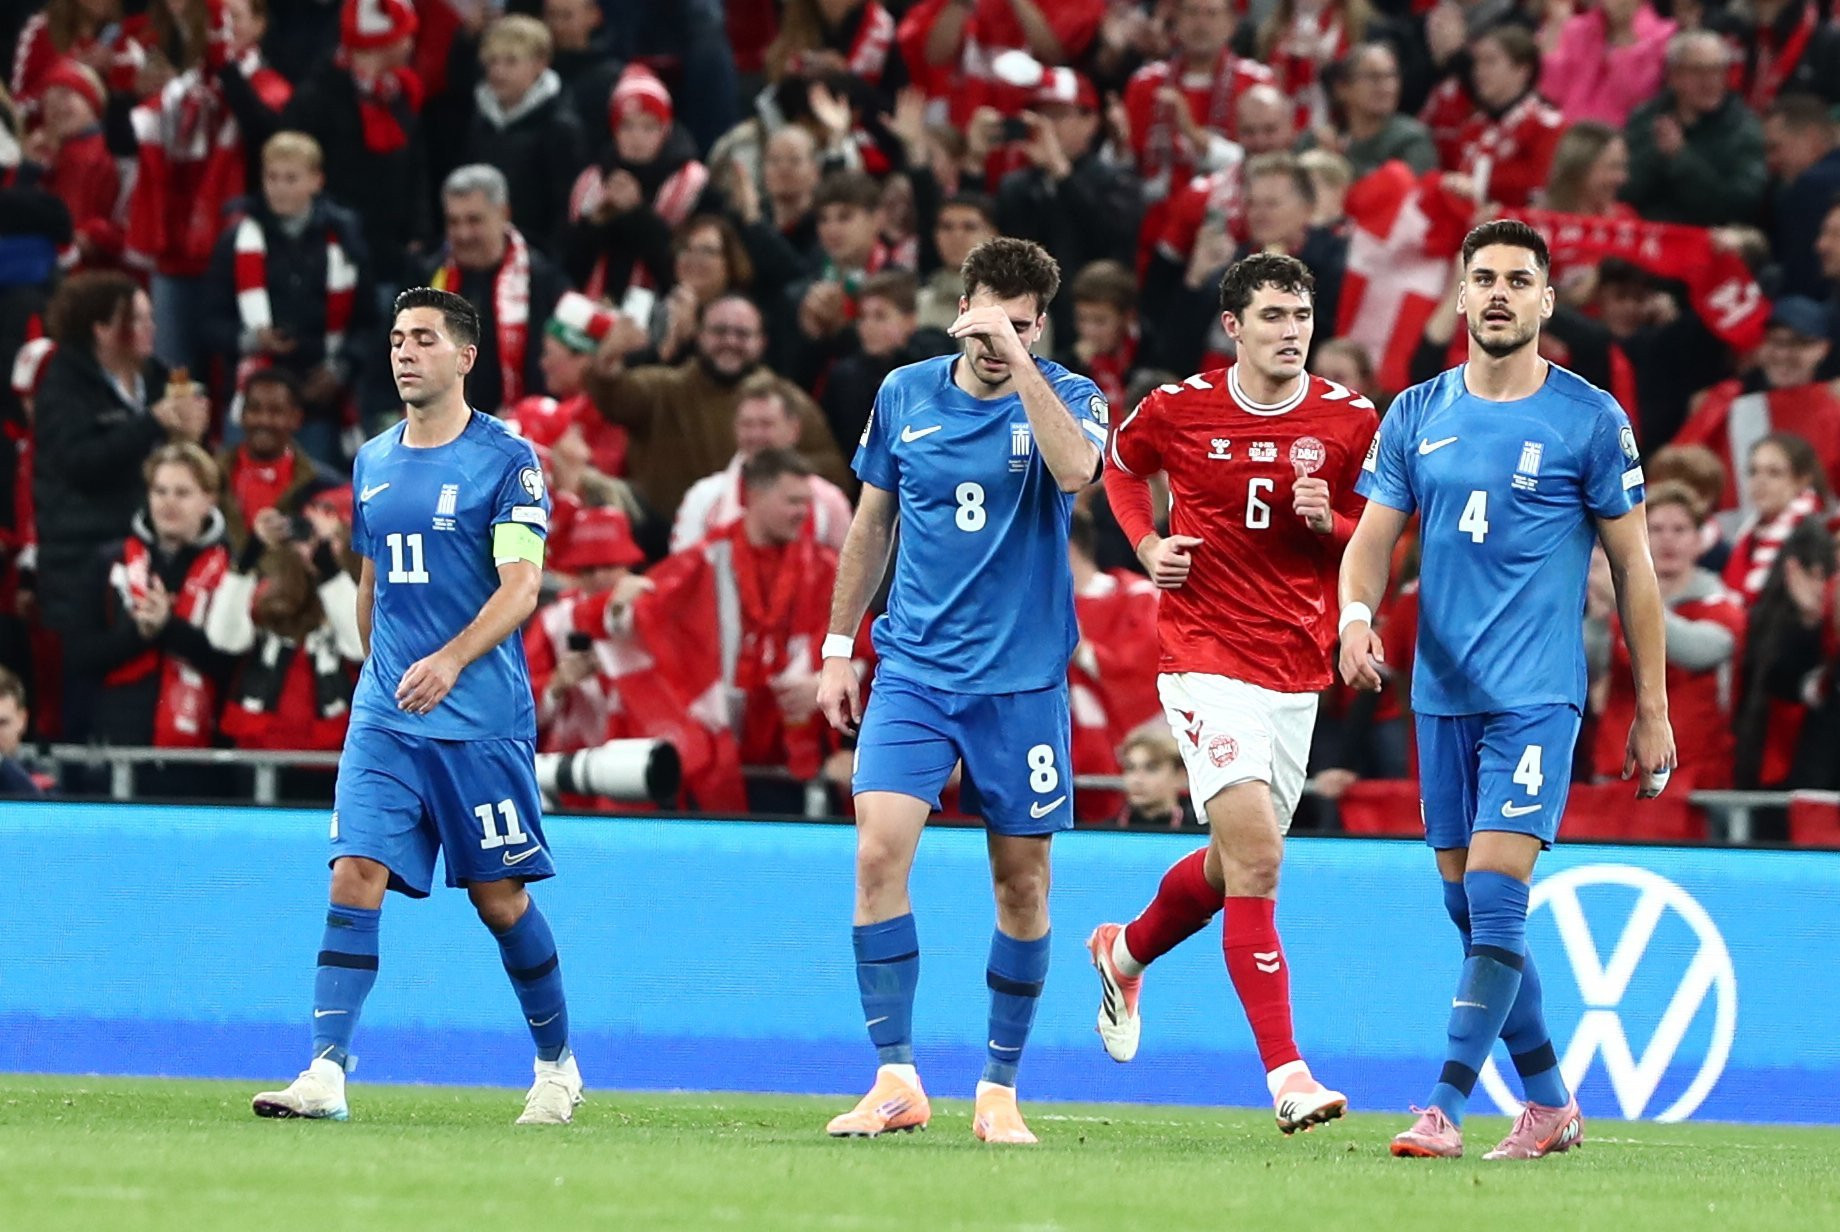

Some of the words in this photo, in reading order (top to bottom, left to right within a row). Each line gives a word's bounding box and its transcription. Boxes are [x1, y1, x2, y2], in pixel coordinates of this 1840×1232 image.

[955, 482, 986, 532] 8
[1246, 477, 1274, 529] 6
[1458, 490, 1489, 543] 4
[387, 533, 429, 583] 11
[1027, 744, 1058, 793] 8
[1513, 745, 1543, 796] 4
[475, 798, 527, 849] 11
